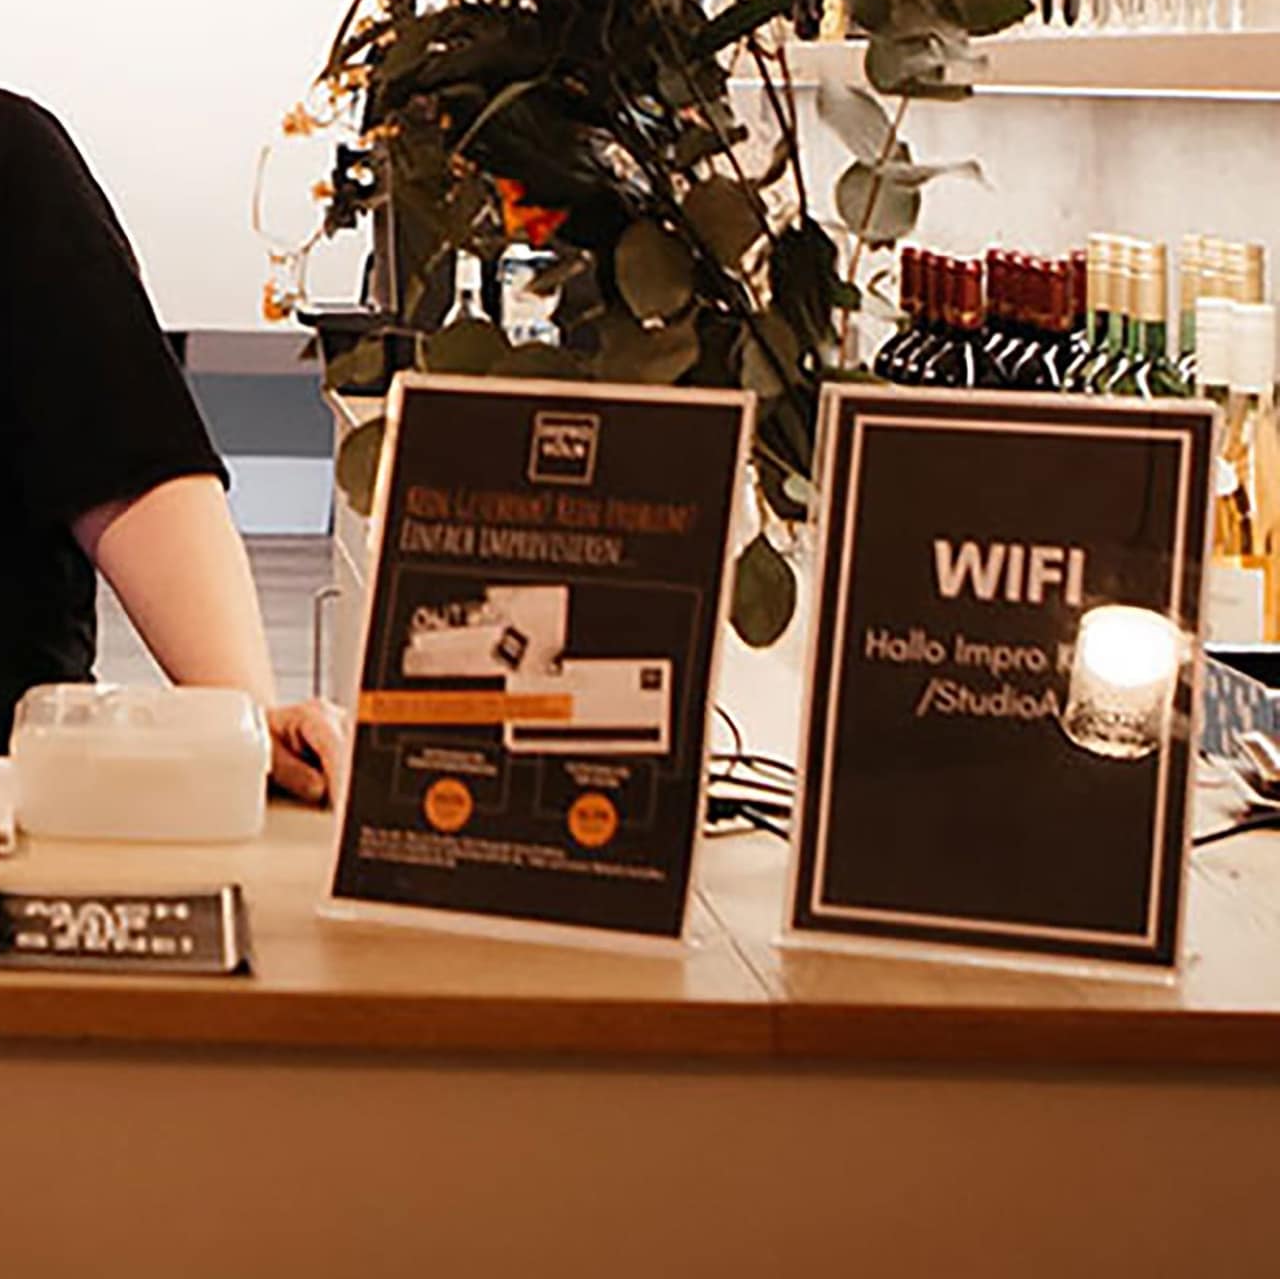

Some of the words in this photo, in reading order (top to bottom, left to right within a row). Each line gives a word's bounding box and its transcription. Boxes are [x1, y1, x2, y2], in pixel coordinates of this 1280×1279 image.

[934, 540, 1086, 606] WIFI
[865, 628, 946, 665] Hallo
[954, 633, 1047, 675] Impro
